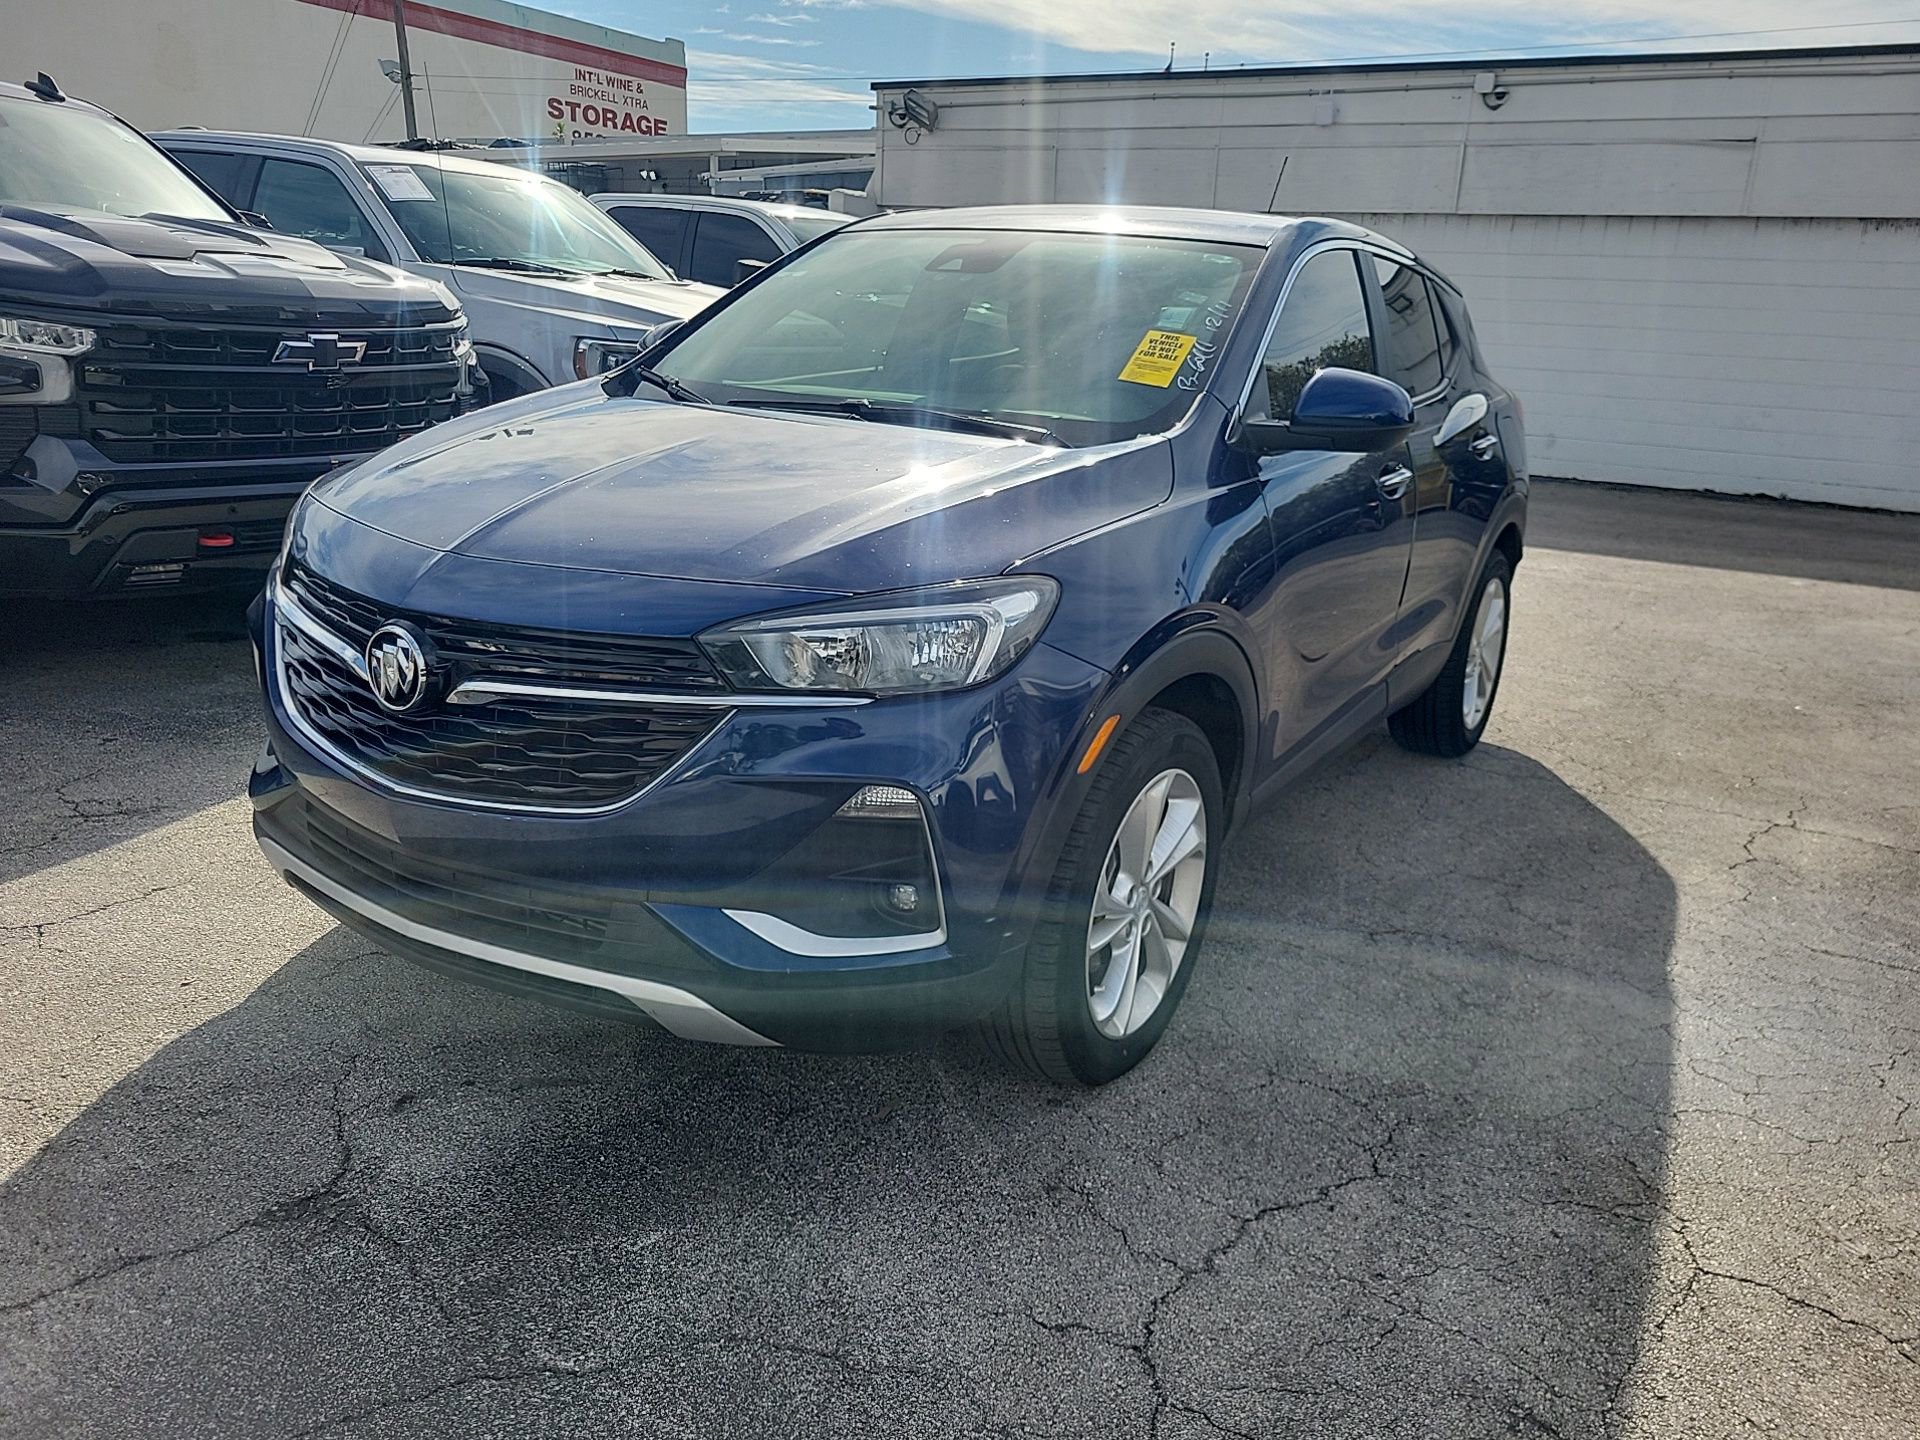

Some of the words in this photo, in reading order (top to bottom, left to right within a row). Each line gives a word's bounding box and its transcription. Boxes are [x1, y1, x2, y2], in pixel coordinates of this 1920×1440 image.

[574, 68, 603, 85] INT'L
[605, 75, 634, 92] WINE
[635, 82, 644, 95] &
[569, 83, 619, 104] BRICKELL
[622, 95, 649, 111] XTRA
[547, 97, 668, 137] STORAGE
[1148, 338, 1184, 349] VEHICLE
[1159, 333, 1181, 342] THIS
[1138, 349, 1157, 358] FOR
[1156, 352, 1179, 361] SALE
[1158, 346, 1177, 354] NOT
